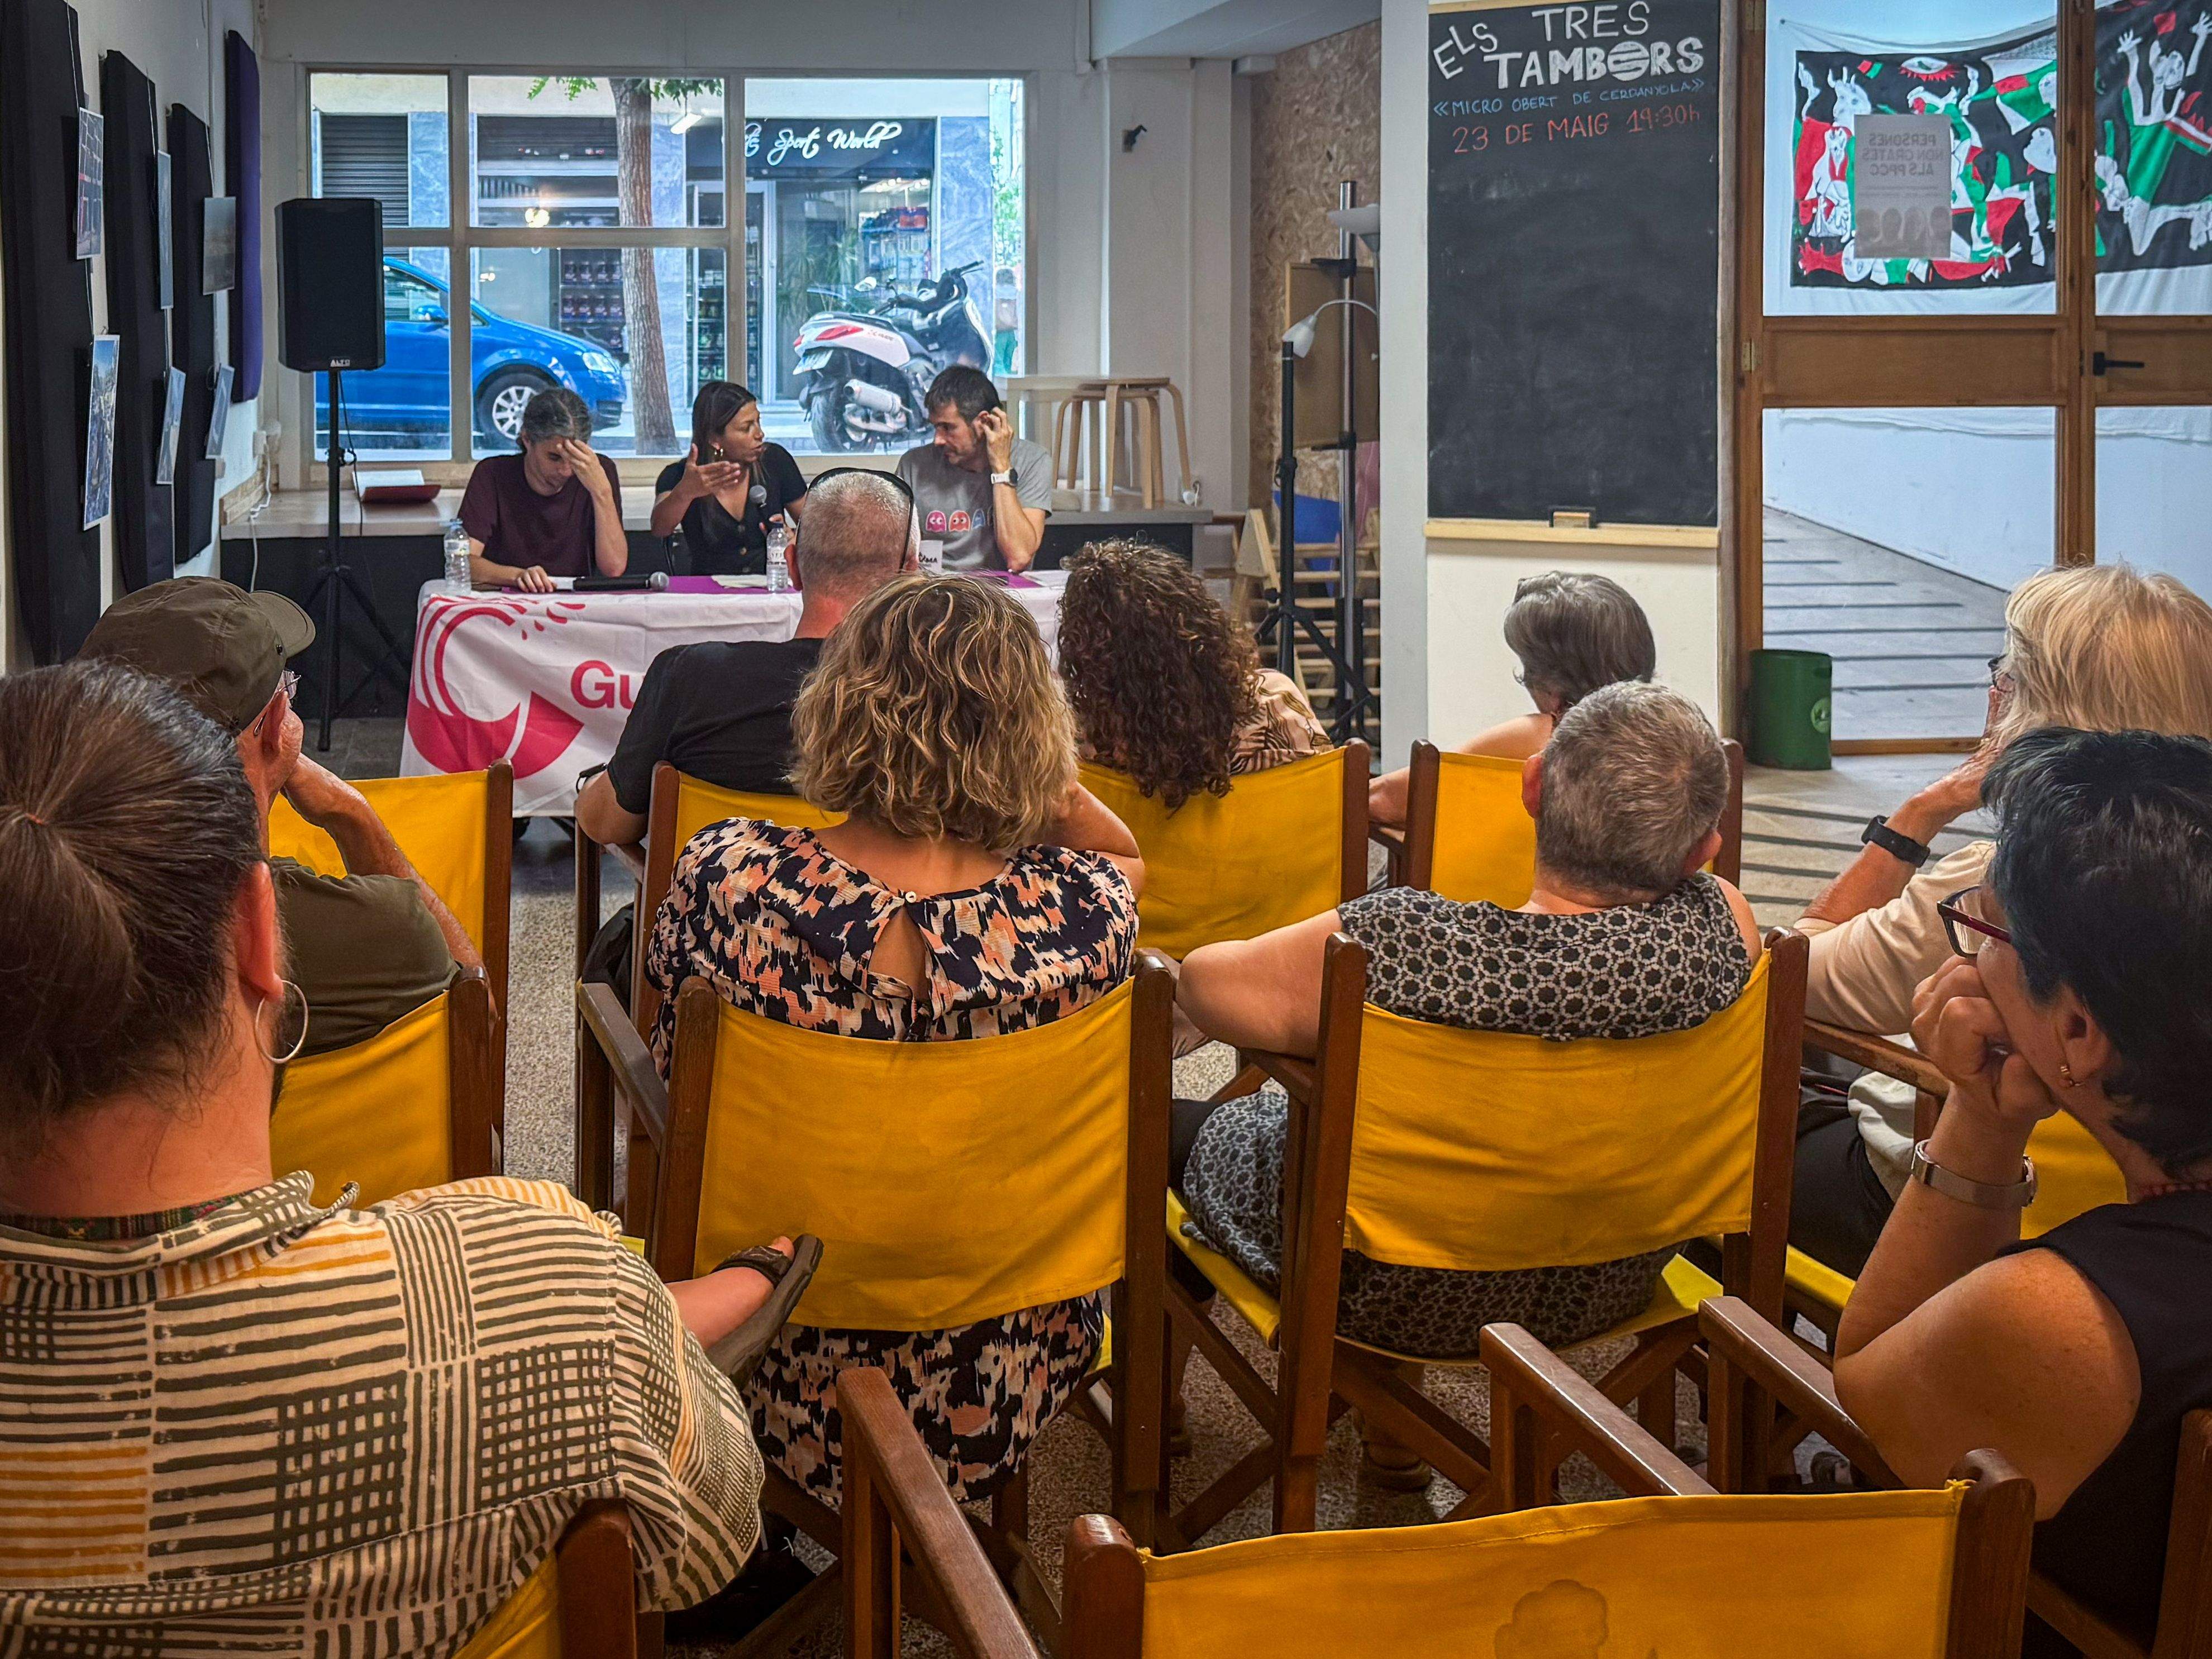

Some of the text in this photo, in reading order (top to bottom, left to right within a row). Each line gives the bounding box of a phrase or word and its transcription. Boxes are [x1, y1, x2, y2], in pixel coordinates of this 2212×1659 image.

[1433, 1, 1650, 79] ELS TRES
[1484, 37, 1704, 89] TAMBORS
[1512, 96, 1557, 112] OBERT
[1572, 91, 1592, 105] DE
[827, 121, 902, 149] World
[1452, 126, 1488, 153] 23
[1505, 123, 1534, 145] DE
[1547, 113, 1609, 141] MAIG
